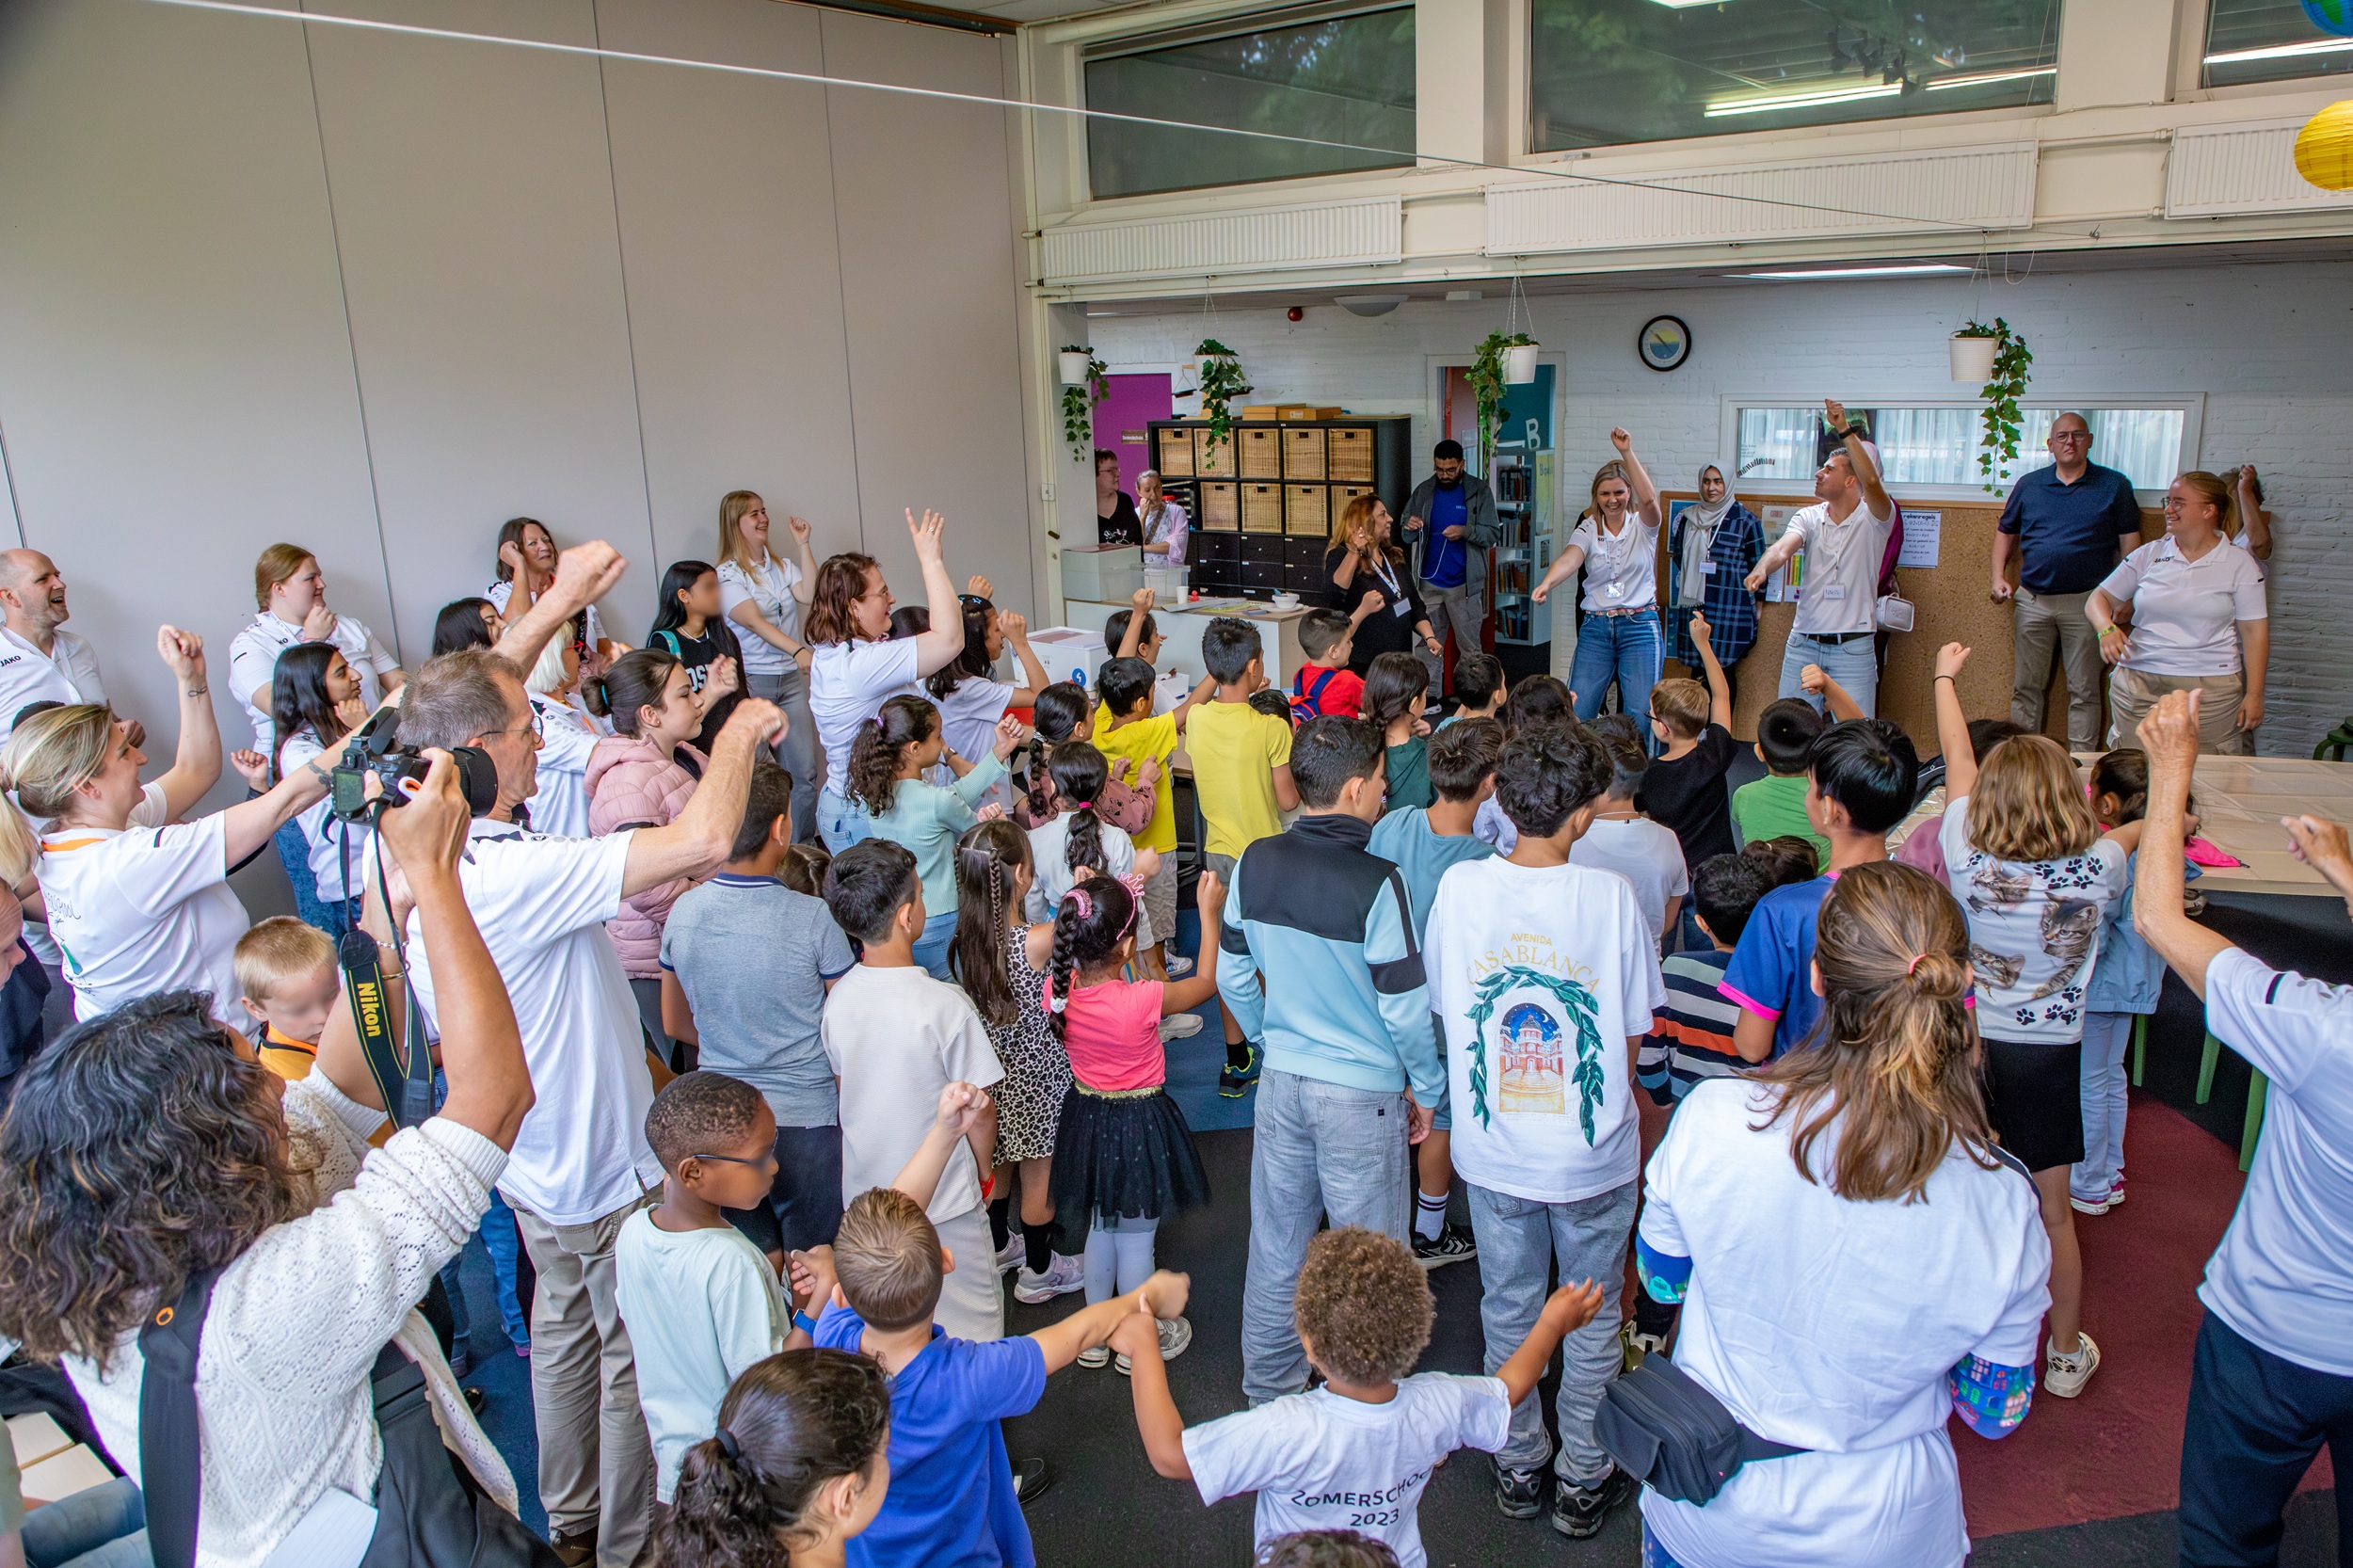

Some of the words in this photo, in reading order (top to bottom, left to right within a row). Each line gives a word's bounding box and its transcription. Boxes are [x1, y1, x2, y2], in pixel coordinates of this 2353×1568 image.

[1525, 417, 1541, 451] B
[0, 655, 22, 667] JAKO
[1511, 933, 1553, 947] AVENIDA
[1466, 944, 1601, 995] CASABLANCA
[357, 982, 381, 1037] Nikon
[1350, 1508, 1400, 1527] 2023
